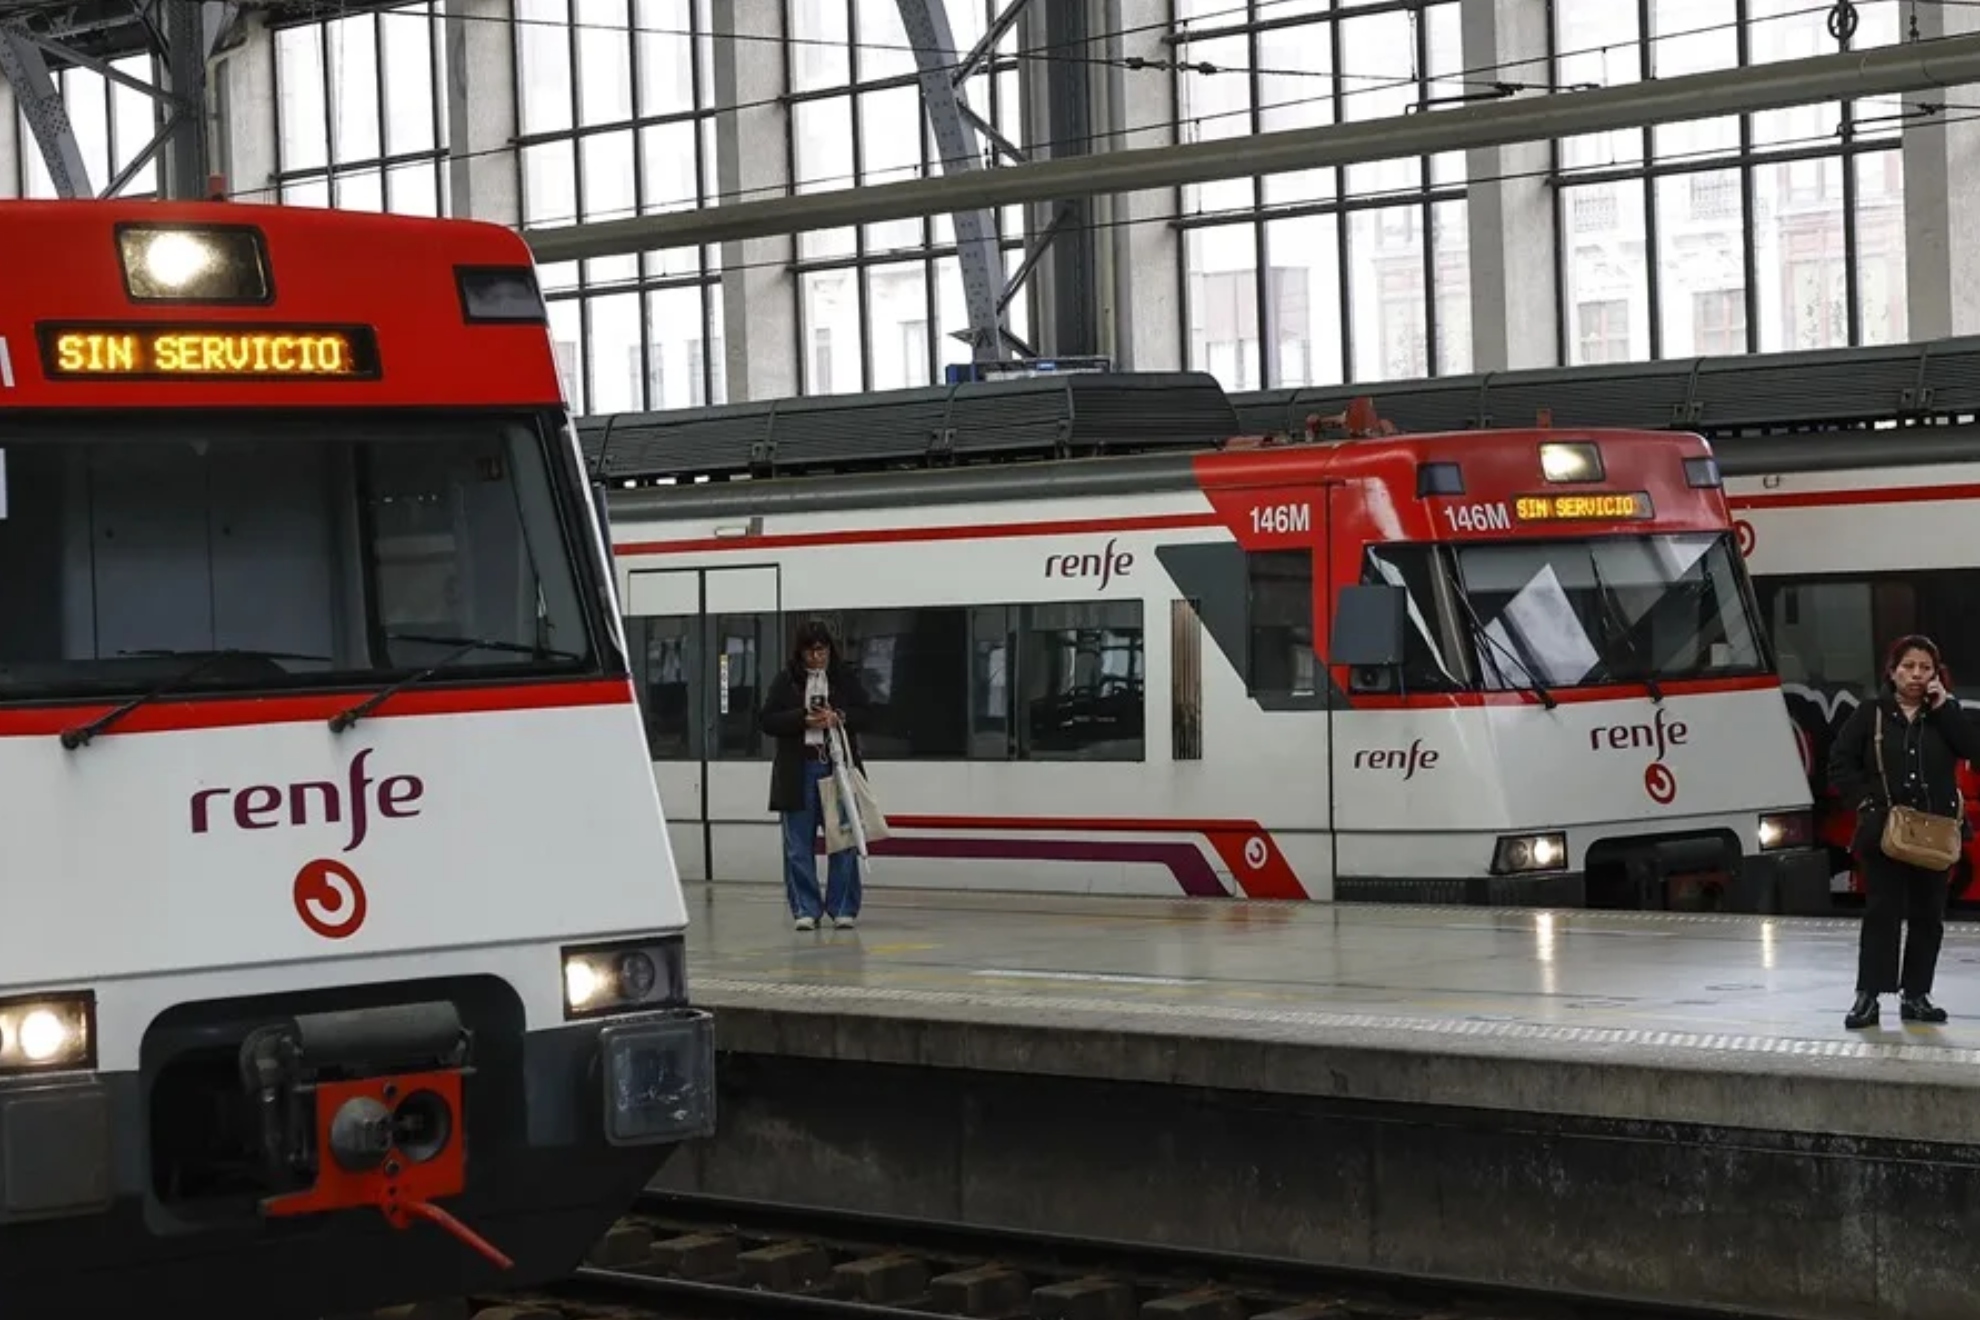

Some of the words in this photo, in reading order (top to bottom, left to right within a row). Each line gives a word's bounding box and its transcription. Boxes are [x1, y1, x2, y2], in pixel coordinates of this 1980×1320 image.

[57, 334, 135, 371] SIN
[153, 334, 343, 372] SERVICIO
[1249, 503, 1310, 534] 146M
[1444, 502, 1511, 533] 146M
[1515, 497, 1549, 520] SIN
[1555, 495, 1635, 519] SERVICIO
[1044, 538, 1135, 592] renfe
[1589, 706, 1689, 762] renfe
[1353, 737, 1440, 782] renfe
[190, 747, 424, 852] renfe
